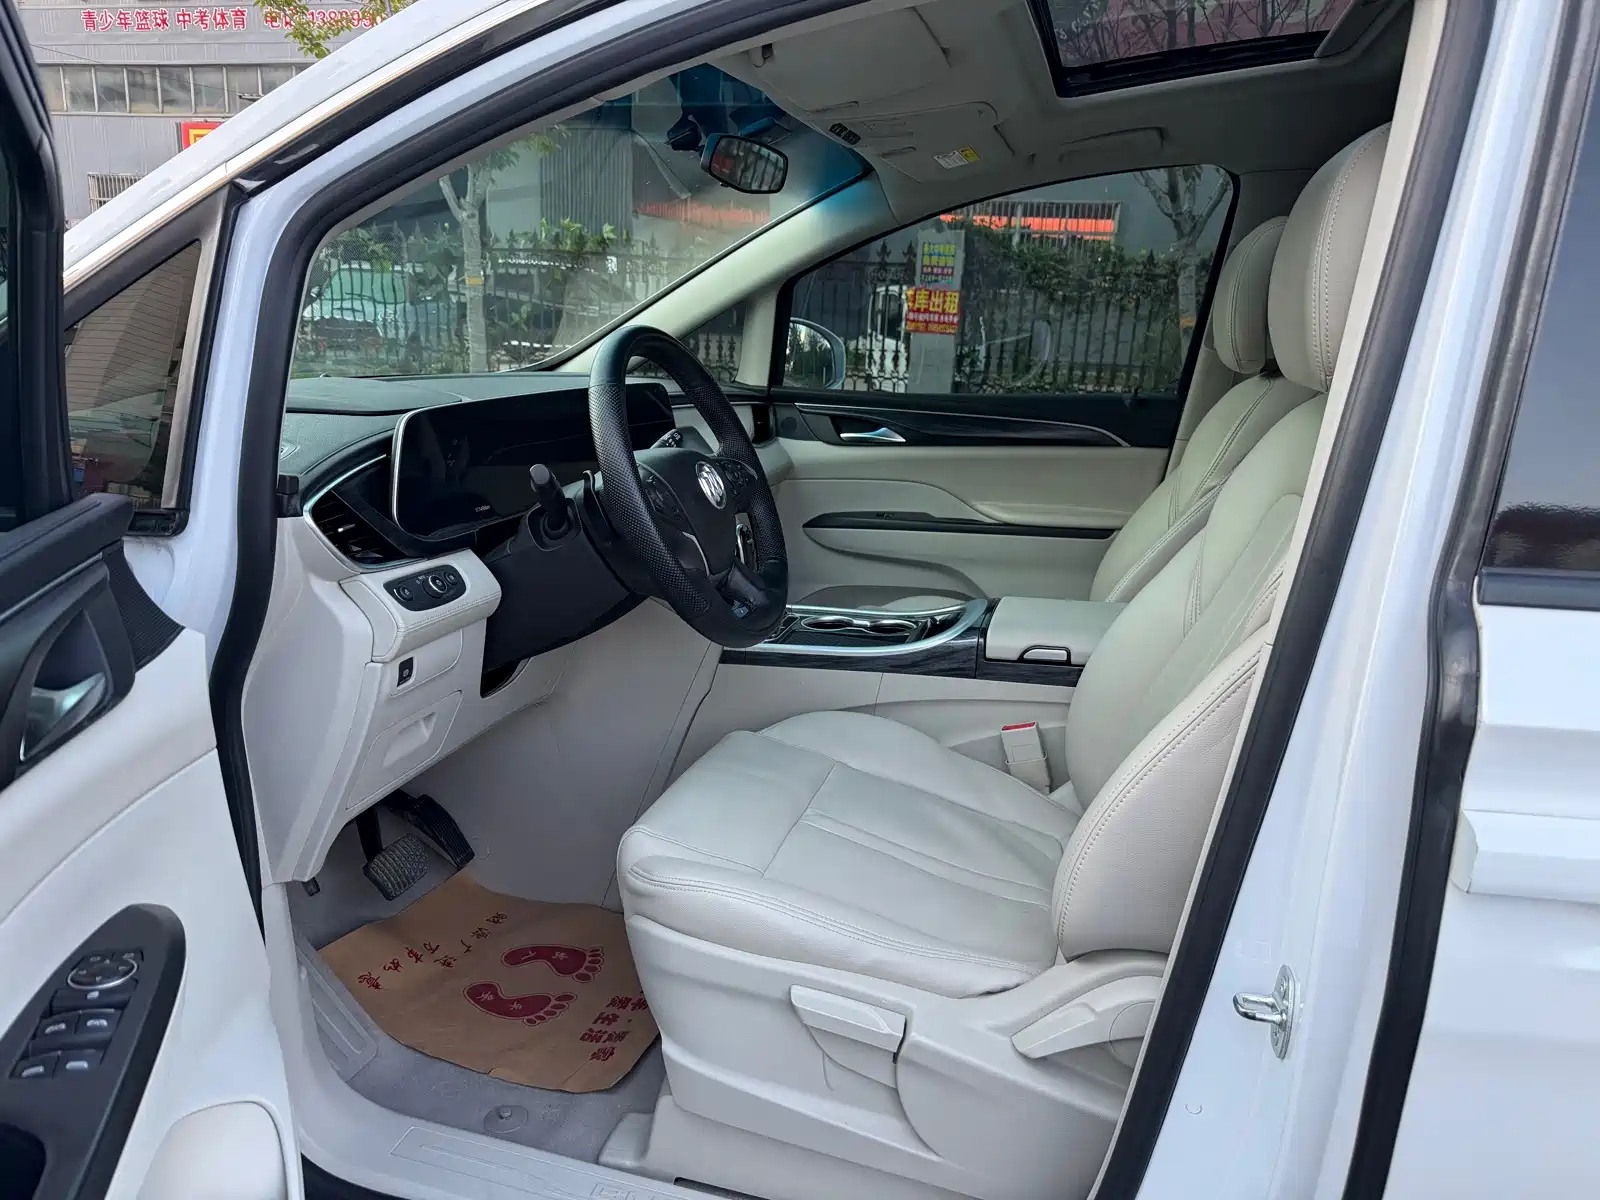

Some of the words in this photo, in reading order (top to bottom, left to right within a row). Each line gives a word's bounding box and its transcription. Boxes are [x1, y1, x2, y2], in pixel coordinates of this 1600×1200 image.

[81, 9, 169, 31] 青少年篮球
[175, 7, 247, 31] 中考体育
[357, 940, 441, 990] 万事如意
